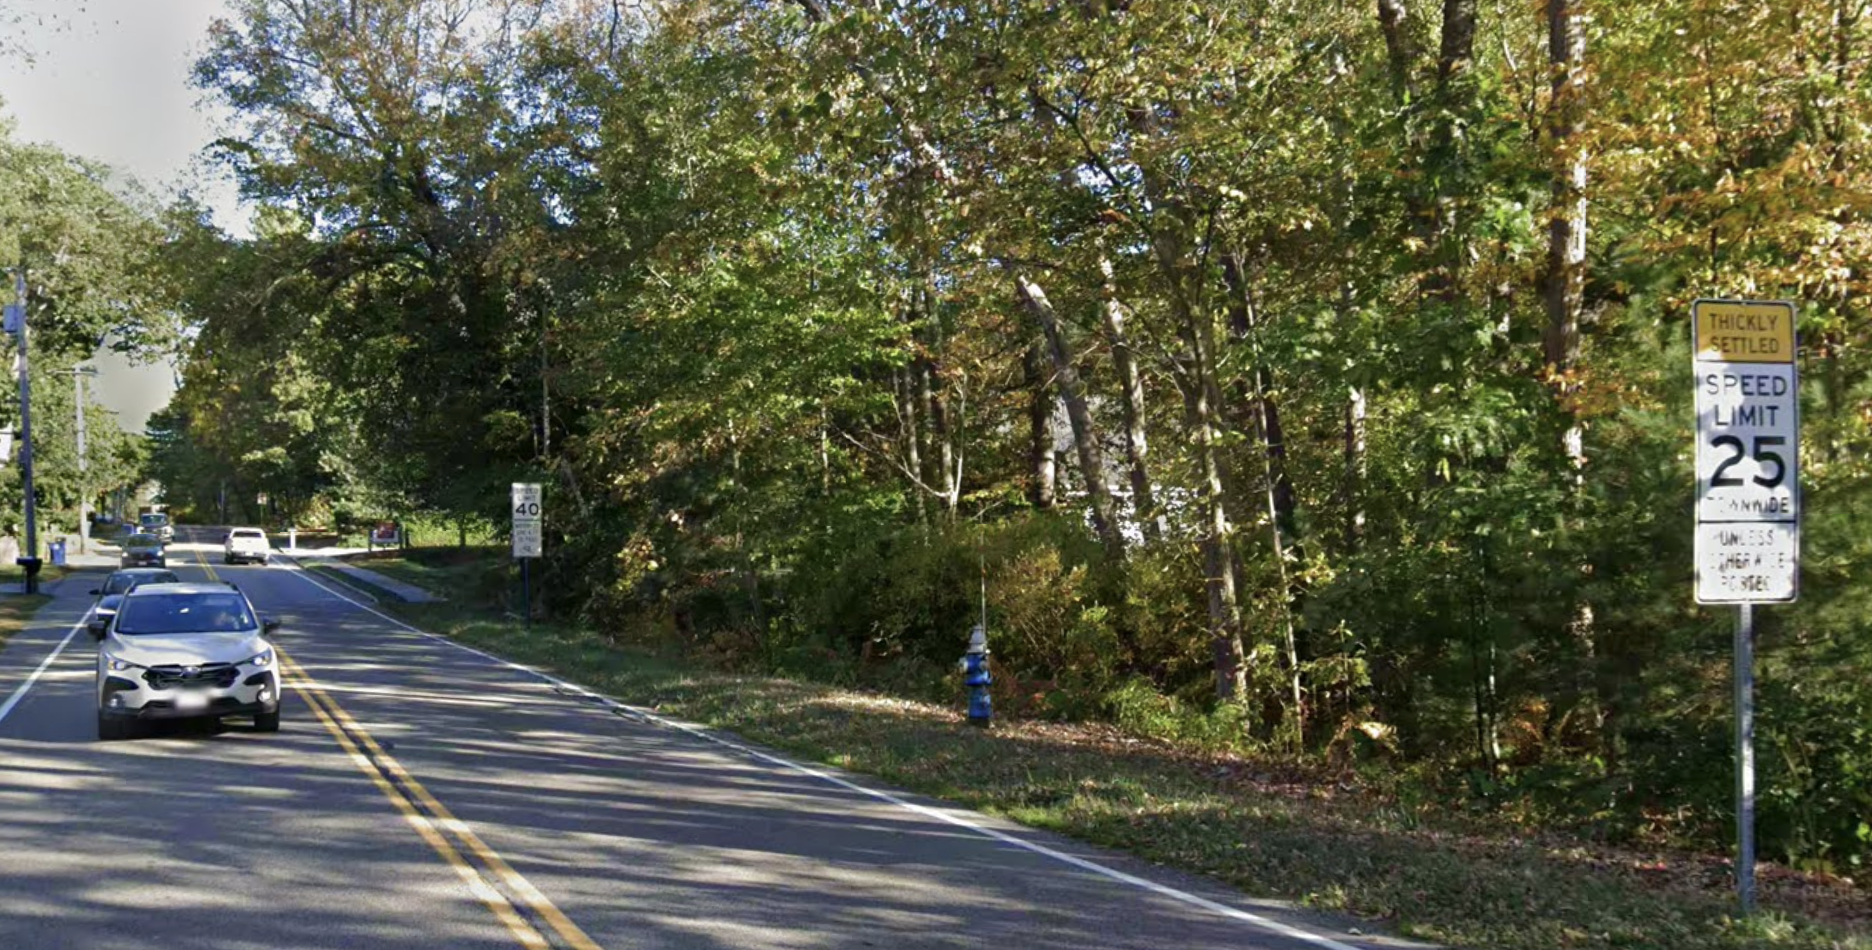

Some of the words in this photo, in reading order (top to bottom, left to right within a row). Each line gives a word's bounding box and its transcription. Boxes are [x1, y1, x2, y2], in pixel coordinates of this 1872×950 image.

[1709, 313, 1778, 332] THICKLY
[1710, 335, 1779, 354] SETTLED
[1706, 374, 1787, 396] SPEED
[1714, 405, 1779, 426] LIMIT
[1710, 434, 1786, 489] 25
[515, 502, 539, 517] 40
[1706, 496, 1789, 514] NWIDE
